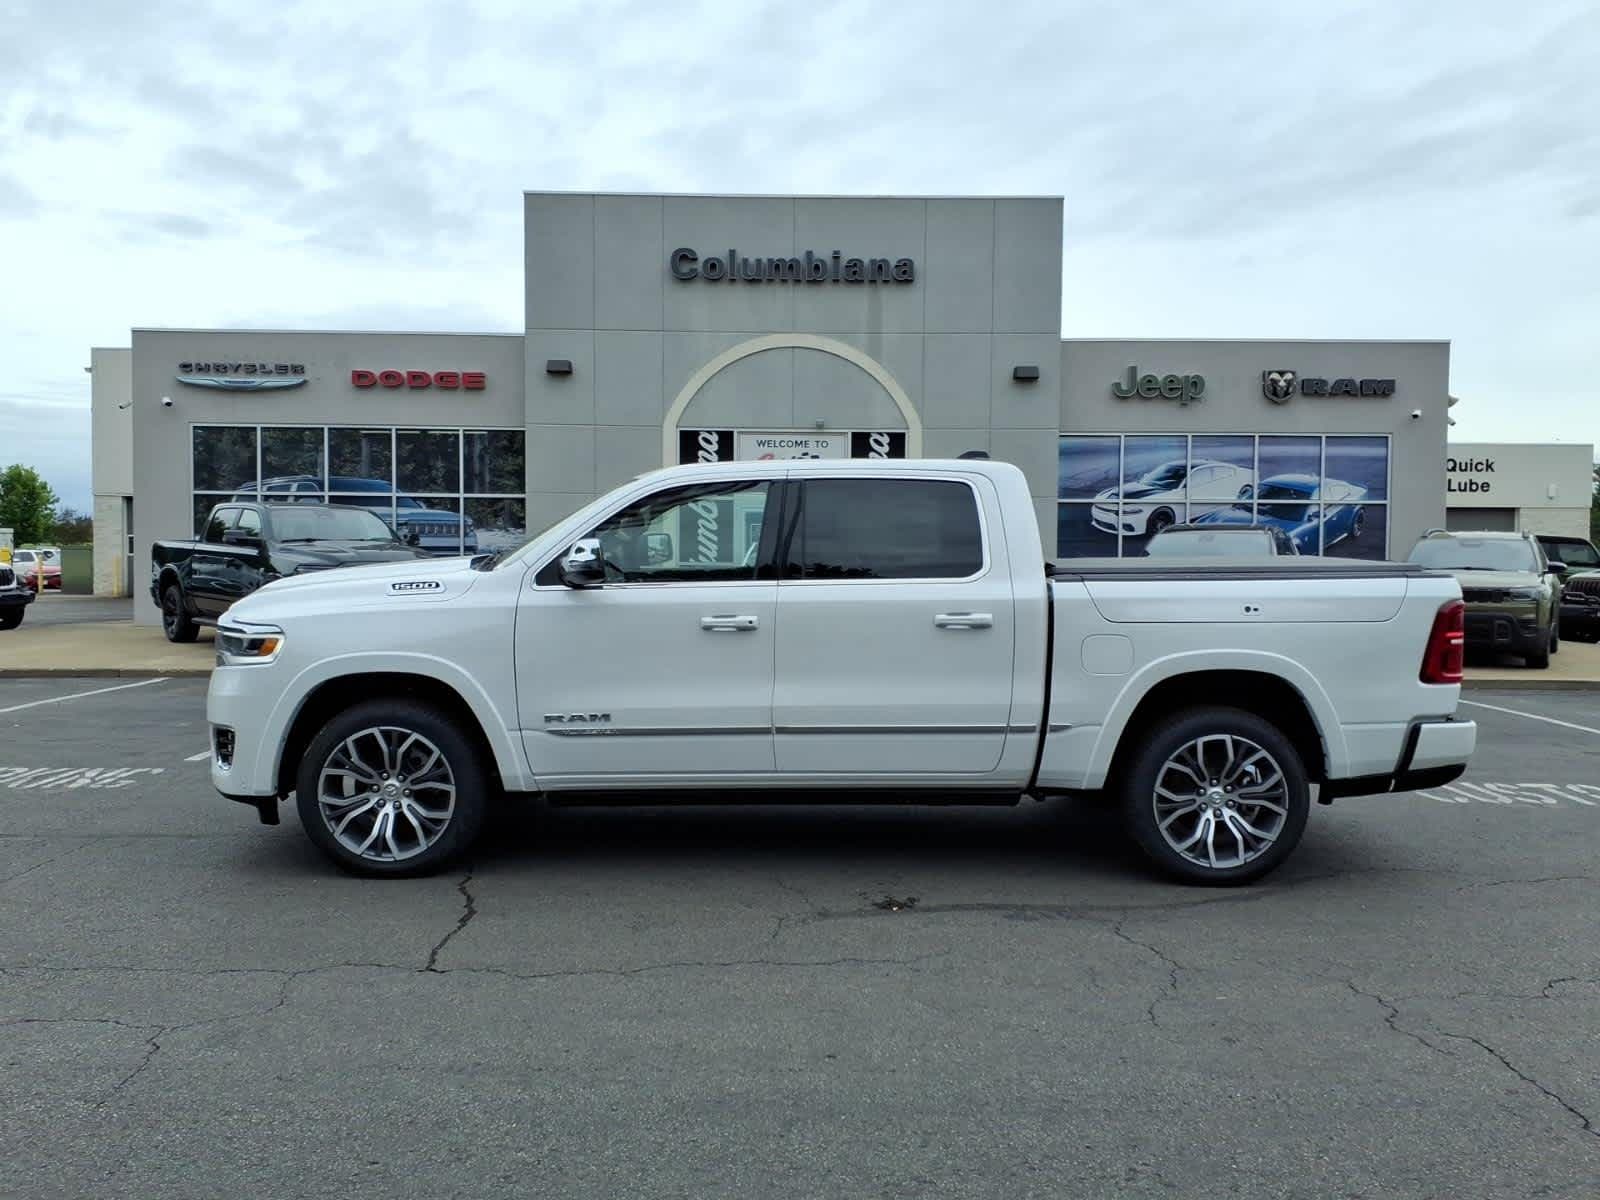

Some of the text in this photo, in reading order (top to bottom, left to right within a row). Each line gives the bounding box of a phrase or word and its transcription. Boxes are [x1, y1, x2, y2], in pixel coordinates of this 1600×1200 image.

[670, 247, 915, 283] Columbiana
[179, 362, 305, 375] CHRYSLER
[351, 369, 486, 390] DODGE
[1111, 365, 1206, 403] Jeep
[1301, 378, 1396, 397] RAM
[756, 439, 829, 449] WELCOME TO
[1446, 458, 1496, 473] Quick
[1447, 478, 1491, 493] Lube
[392, 582, 440, 591] 1500
[543, 713, 611, 724] RAM
